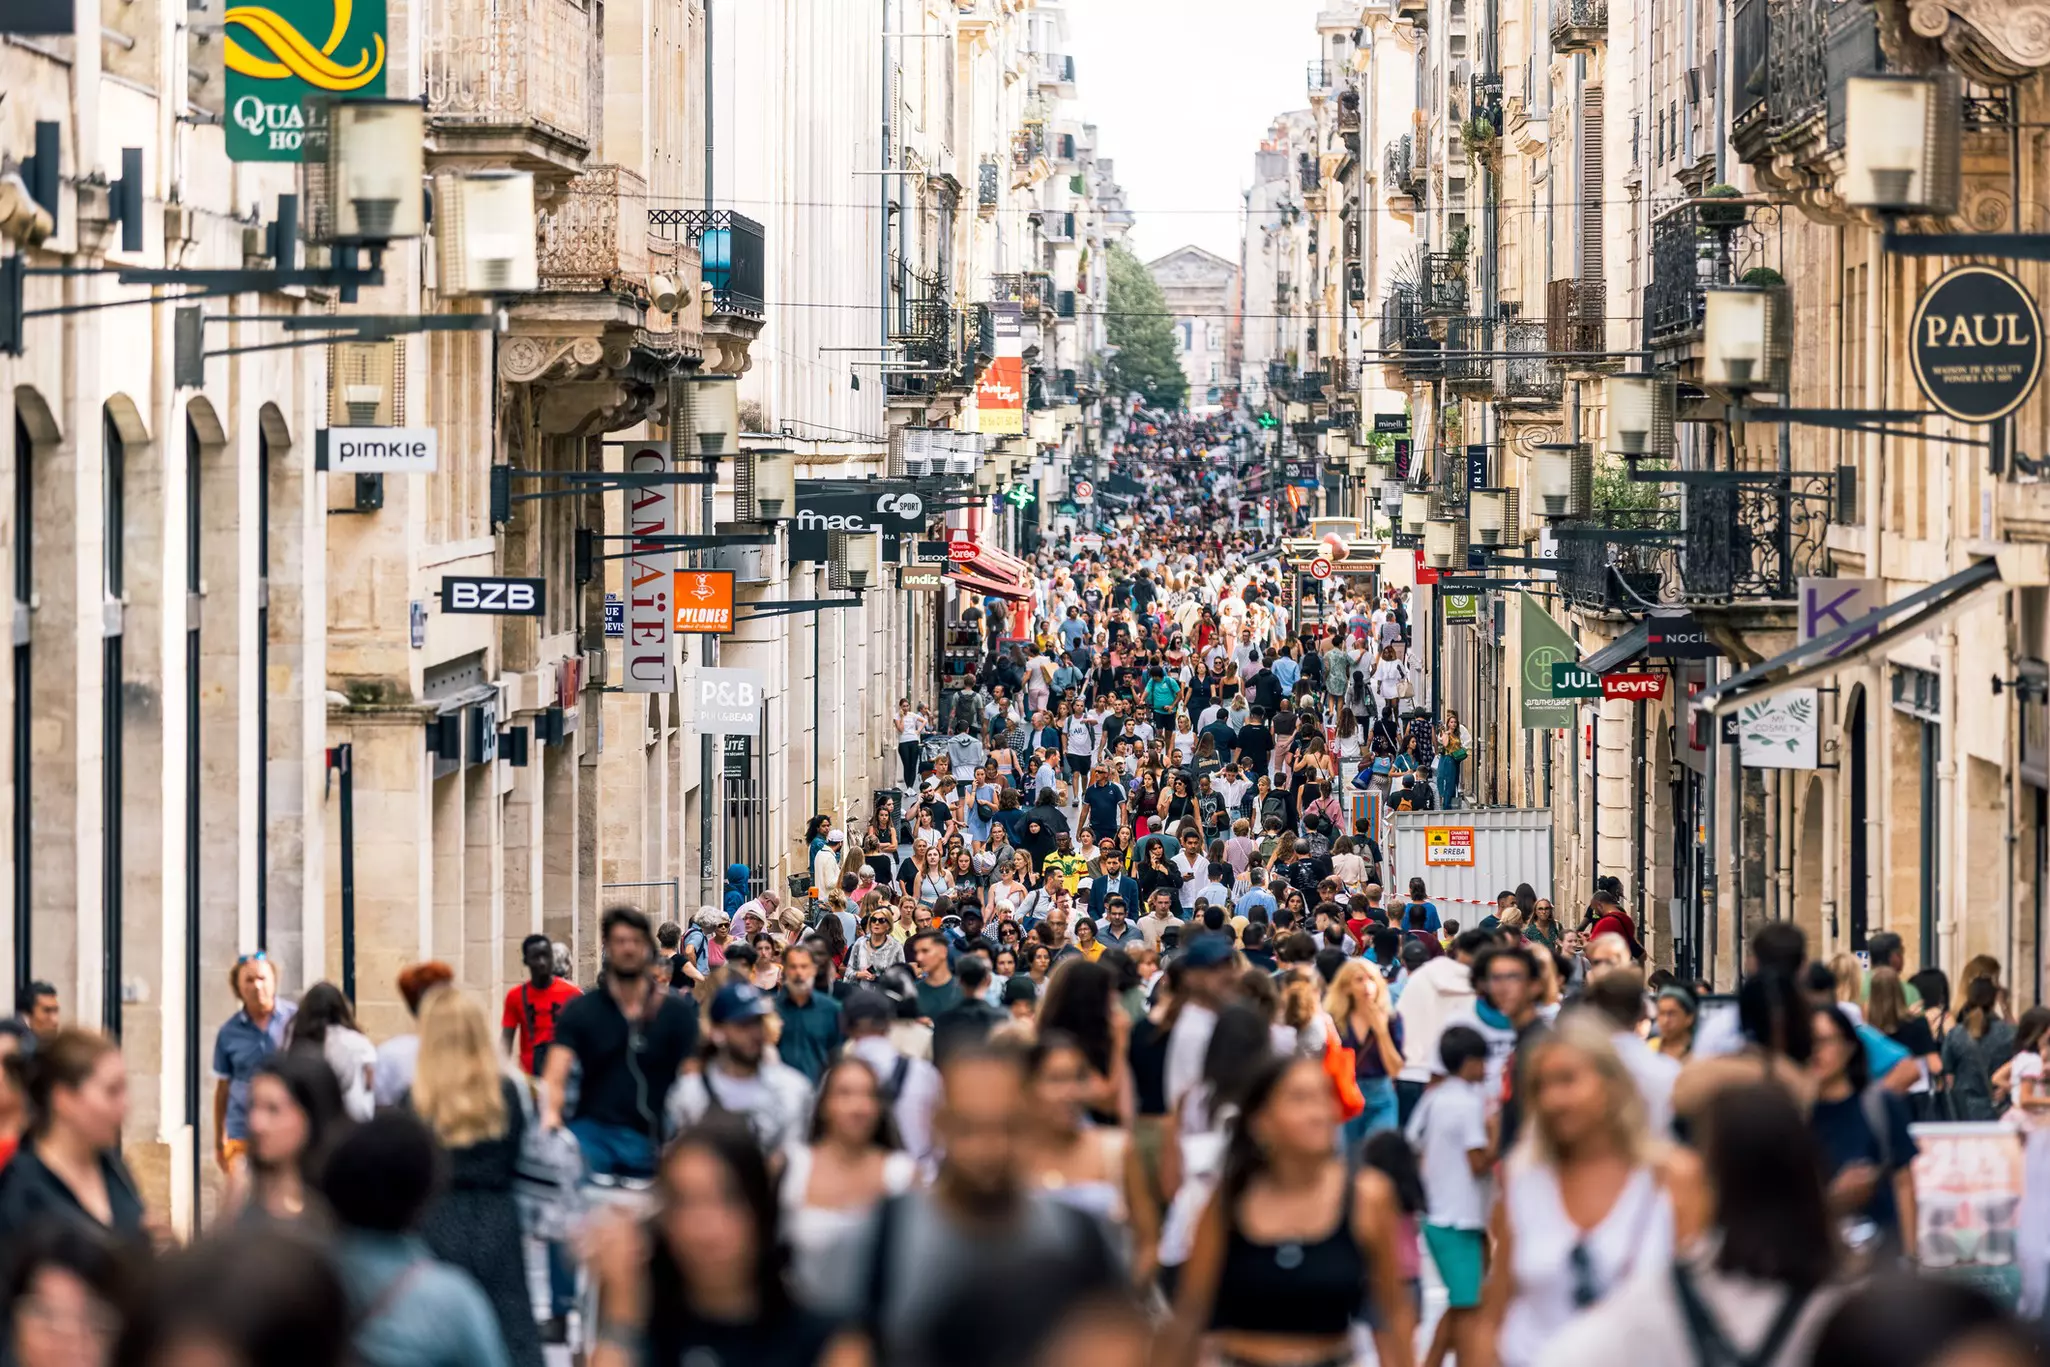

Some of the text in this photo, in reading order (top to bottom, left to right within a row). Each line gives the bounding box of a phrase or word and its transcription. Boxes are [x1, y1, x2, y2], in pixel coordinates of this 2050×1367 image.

[233, 95, 328, 136] QUAL
[1925, 314, 2030, 348] PAUL
[1379, 420, 1403, 428] minelli
[340, 442, 426, 462] pimkie
[899, 502, 919, 511] SPORT
[797, 509, 863, 531] fnac
[904, 574, 939, 585] undiz
[452, 582, 535, 610] BZB
[605, 607, 619, 616] UE
[676, 608, 729, 623] PYLONES
[1556, 672, 1602, 689] JUL
[701, 681, 754, 707] P&B
